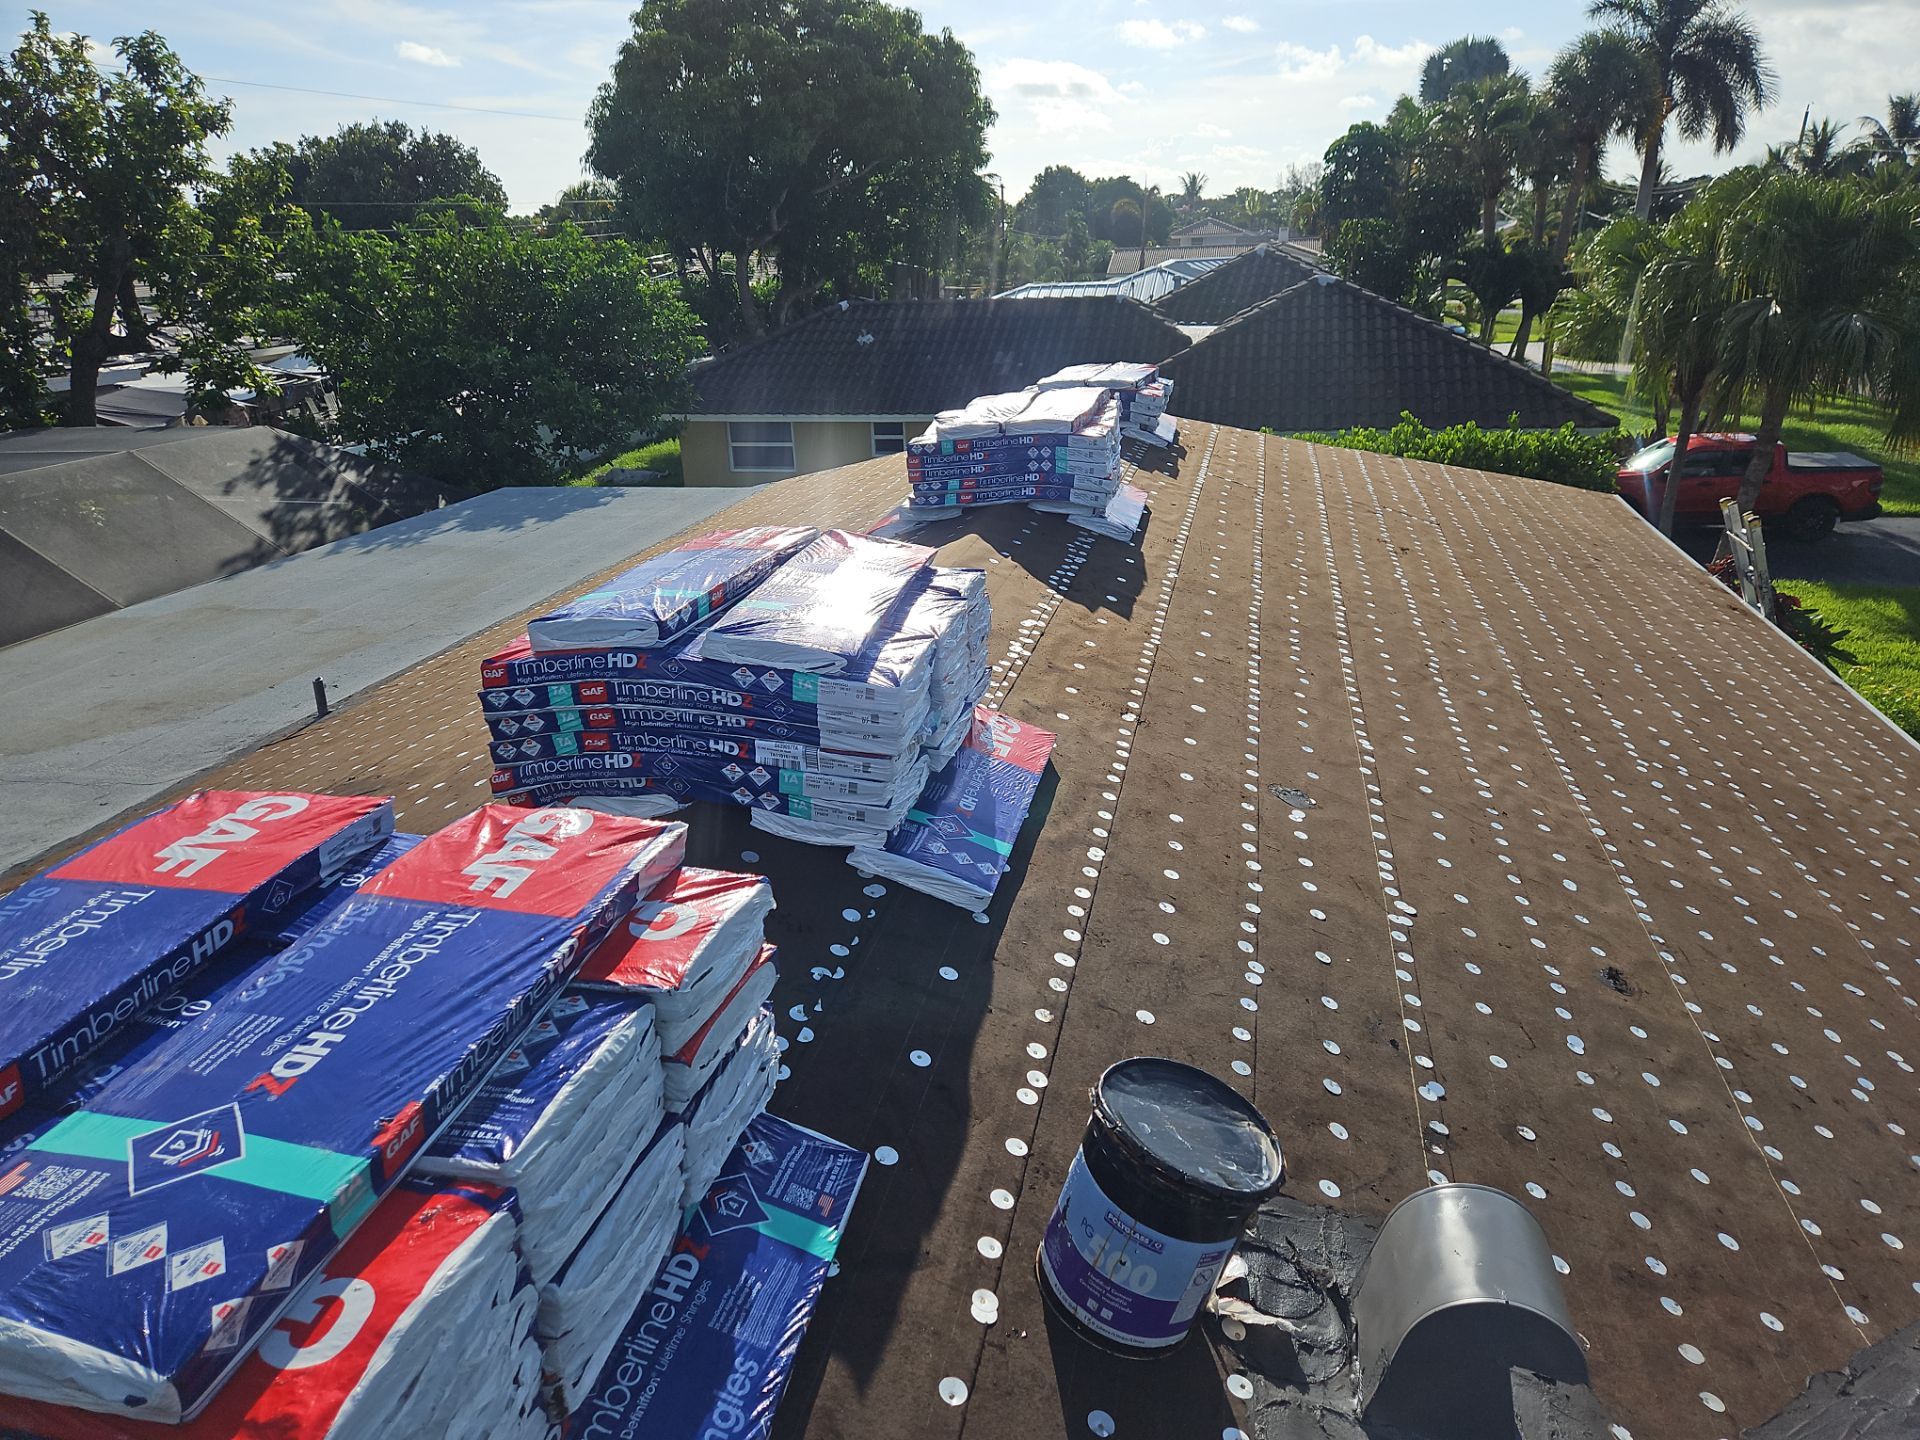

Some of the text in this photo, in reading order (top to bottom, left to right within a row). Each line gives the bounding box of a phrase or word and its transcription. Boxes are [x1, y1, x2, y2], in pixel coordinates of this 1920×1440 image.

[483, 668, 505, 678] GAF
[581, 686, 605, 696] GAF
[590, 713, 612, 721] GAF
[491, 773, 511, 783] GAF
[783, 774, 799, 784] TA
[152, 795, 310, 879] GAF
[462, 808, 595, 899] GAF
[261, 911, 439, 1056] High Definition Lifetime Shingles
[386, 1115, 421, 1160] GAF
[1080, 1216, 1095, 1239] PG
[1107, 1212, 1149, 1245] POLYGLASS
[620, 1279, 713, 1440] Definition Lifetime Shingles
